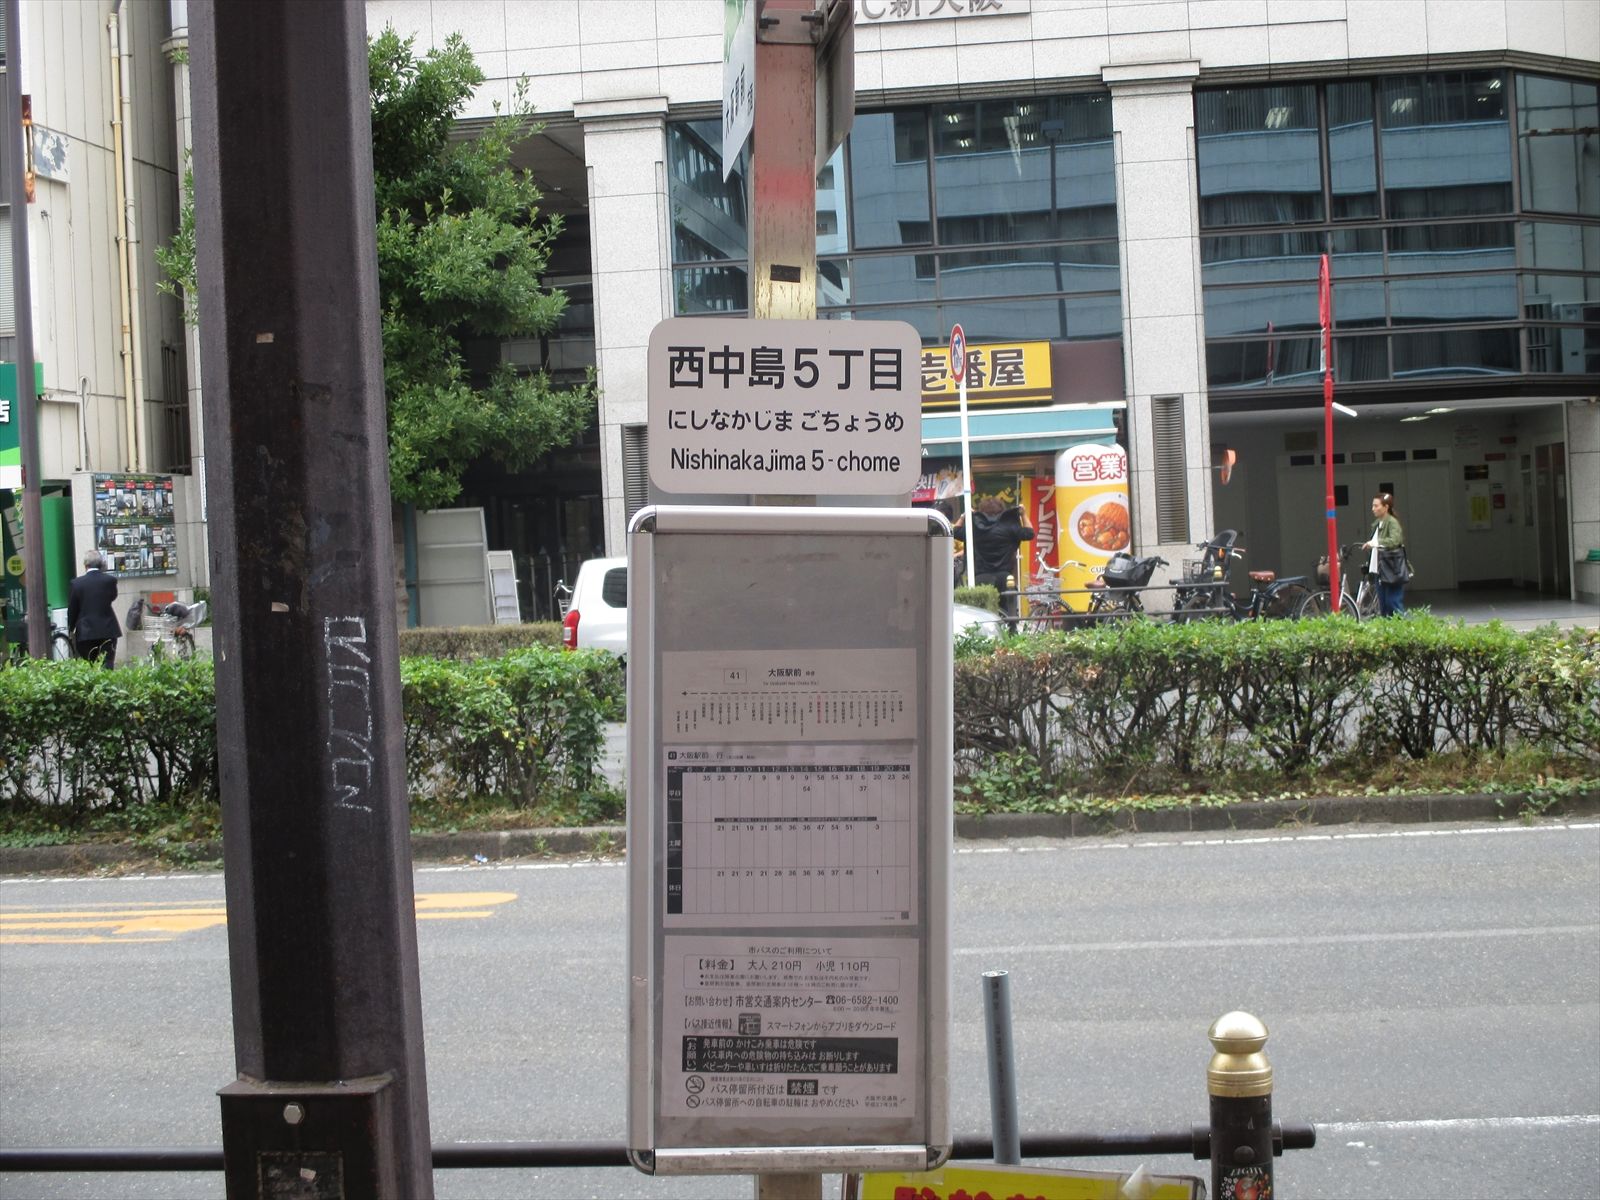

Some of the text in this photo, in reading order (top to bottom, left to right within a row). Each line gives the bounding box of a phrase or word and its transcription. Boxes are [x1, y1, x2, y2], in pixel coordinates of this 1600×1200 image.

[667, 345, 902, 391] 西中島5丁目
[668, 409, 904, 433] にしなかじま ごちょうめ
[670, 448, 806, 473] Nishinakajima
[729, 672, 741, 680] 41
[768, 667, 802, 678] 大阪駅前
[711, 1082, 838, 1096] バス停留所付近は 禁煙 です
